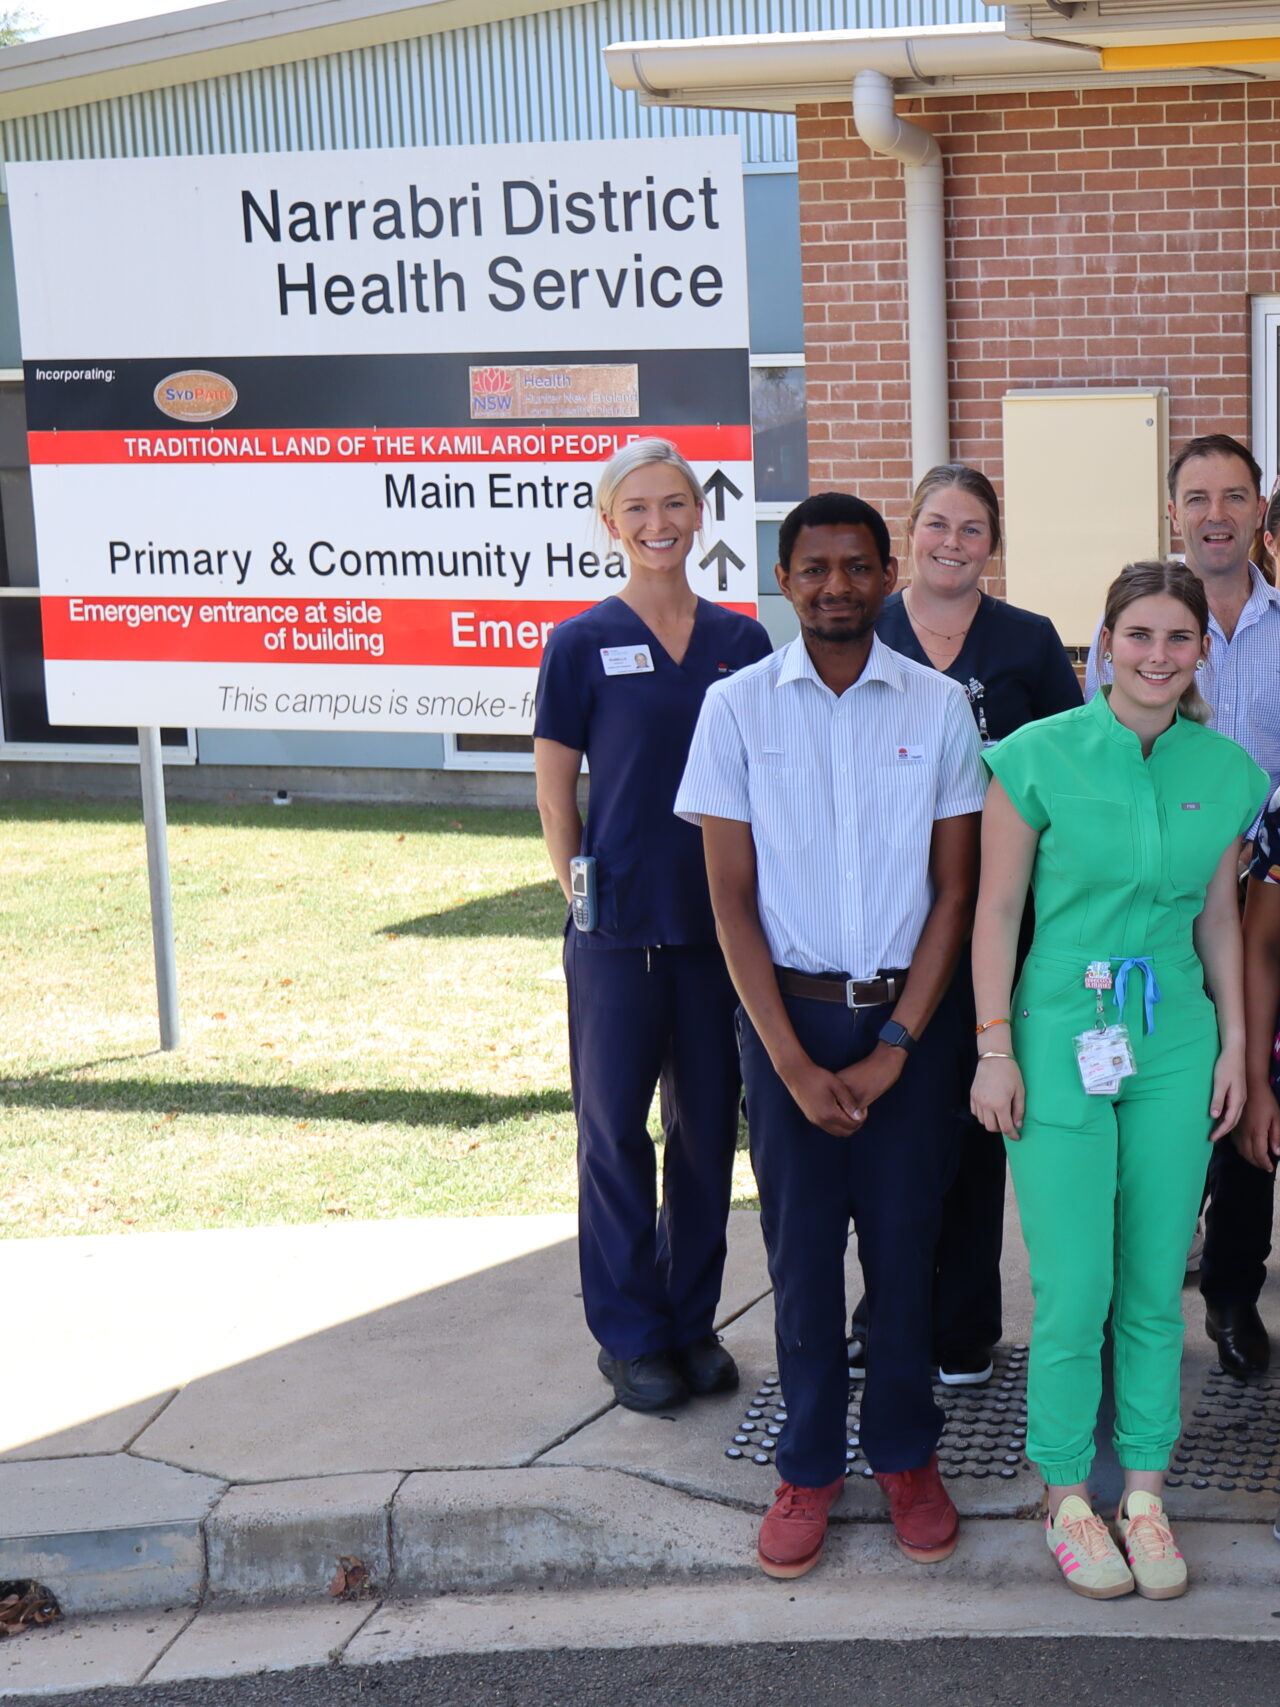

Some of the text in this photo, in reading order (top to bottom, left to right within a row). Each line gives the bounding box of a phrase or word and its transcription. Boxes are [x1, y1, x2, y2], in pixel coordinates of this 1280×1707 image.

[242, 176, 719, 242] Narrabri District
[278, 254, 722, 315] Health Service
[36, 368, 116, 382] Incorporating:
[524, 374, 571, 388] Health
[472, 396, 512, 410] NSW
[124, 437, 266, 456] TRADITIONAL
[272, 437, 330, 455] LAND
[338, 436, 365, 455] OF
[372, 436, 415, 455] THE
[422, 435, 545, 454] KAMILAROI
[386, 474, 474, 508] Main
[110, 542, 251, 584] Primary
[271, 542, 295, 575] &
[309, 541, 531, 587] Community
[70, 599, 381, 627] Emergency entrance at side
[264, 628, 384, 656] of building
[219, 686, 267, 712] This
[276, 694, 382, 719] campus
[389, 690, 409, 714] is
